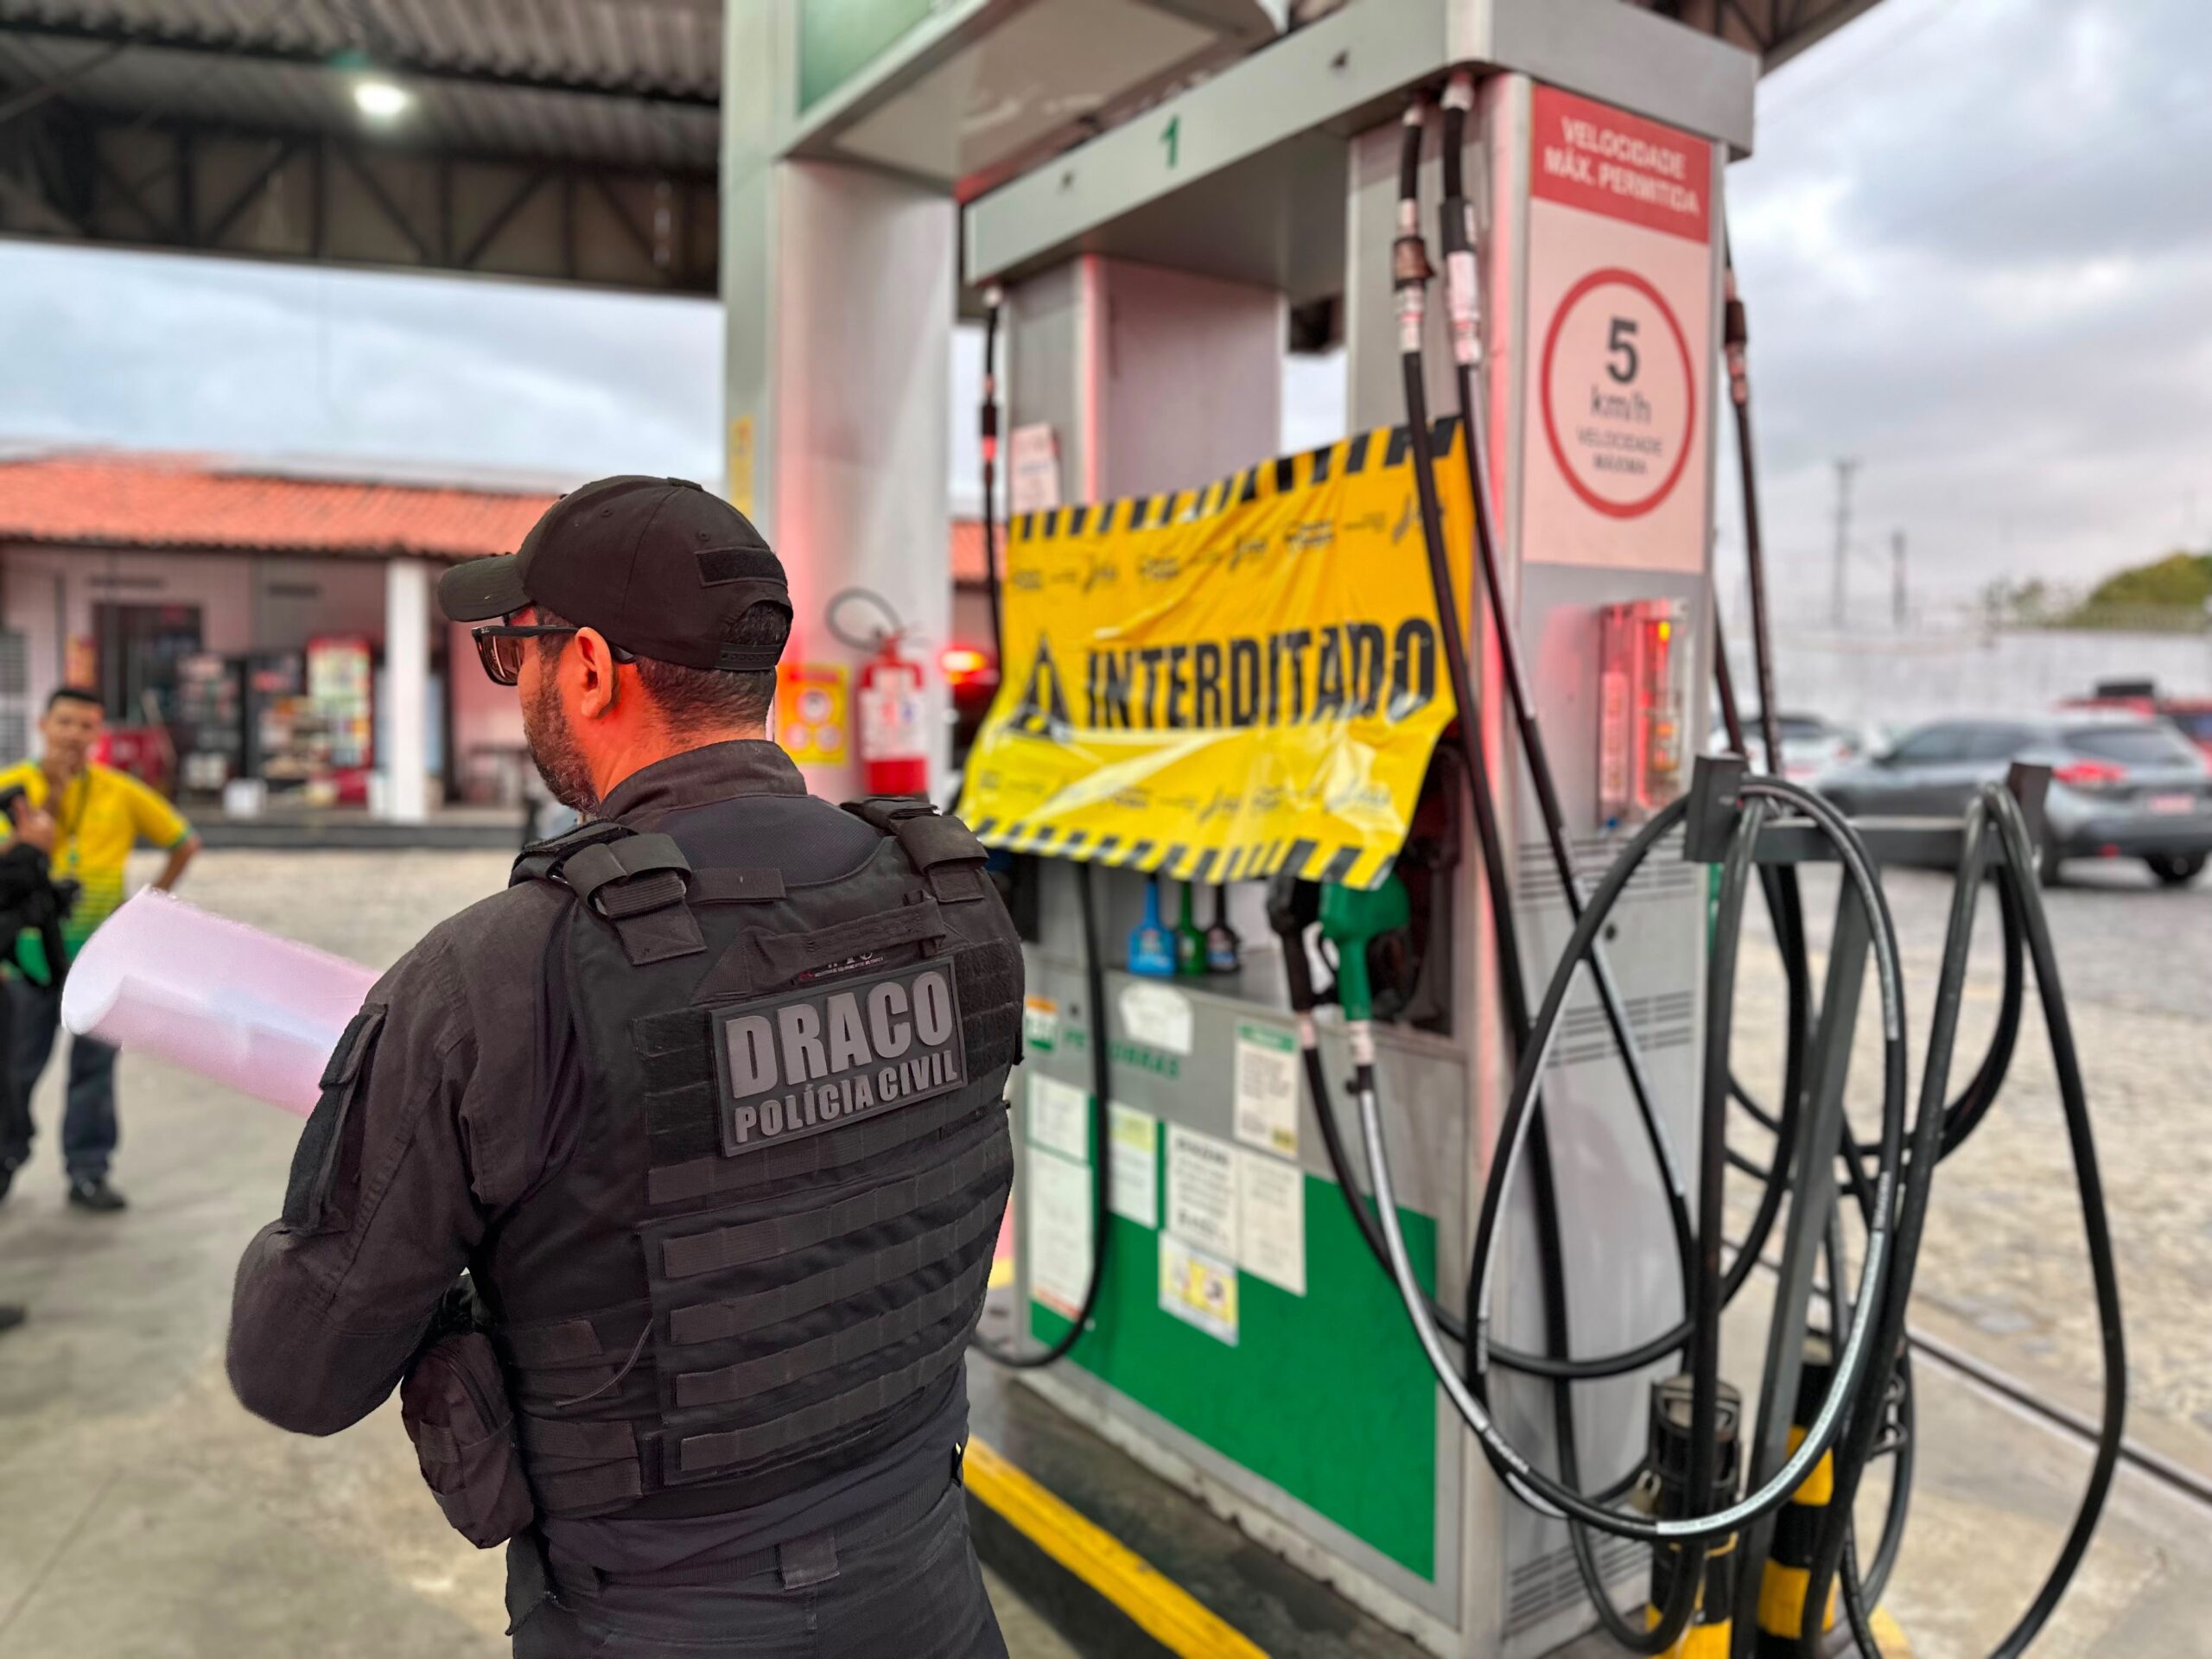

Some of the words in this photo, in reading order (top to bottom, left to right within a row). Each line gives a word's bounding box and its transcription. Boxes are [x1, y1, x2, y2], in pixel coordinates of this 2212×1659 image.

[1160, 115, 1181, 168] 1
[1560, 115, 1686, 181] VELOCIDADE
[1542, 145, 1597, 186] MÁX.
[1599, 162, 1700, 216] PERMITIDA
[1606, 316, 1639, 385] 5
[1591, 386, 1652, 424] km/h
[1086, 616, 1436, 729] INTERDITADO
[725, 971, 953, 1099] DRACO
[734, 1074, 874, 1143] POLÍCIA
[878, 1050, 957, 1102] CIVIL
